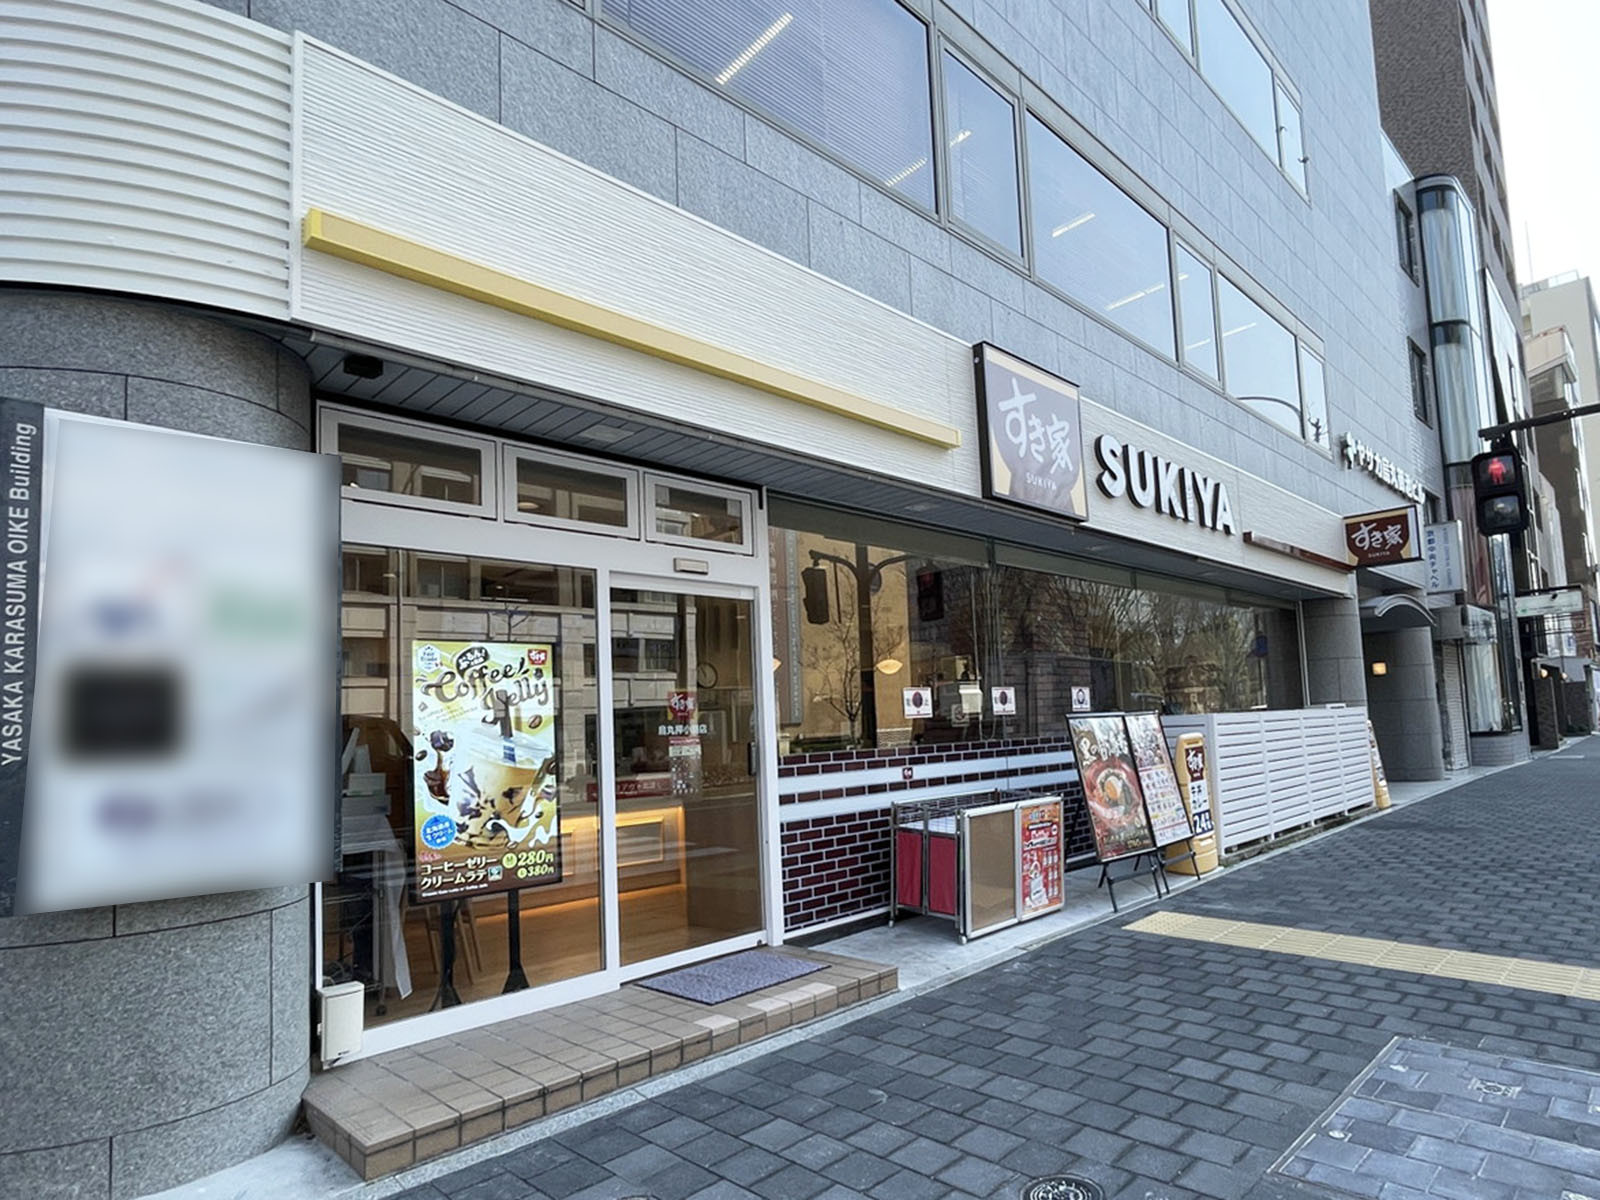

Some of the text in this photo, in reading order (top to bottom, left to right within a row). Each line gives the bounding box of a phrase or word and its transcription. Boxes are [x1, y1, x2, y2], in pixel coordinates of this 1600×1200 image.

[999, 377, 1073, 474] すき家
[1026, 472, 1057, 491] SUKIYA
[1095, 434, 1236, 536] SUKIYA
[1351, 522, 1403, 550] すき家
[1, 422, 37, 766] YASAKA KARASUMA OIKE Building
[481, 676, 549, 725] Jelly
[421, 856, 498, 876] コーヒーゼリー
[421, 868, 487, 890] クリームラテ
